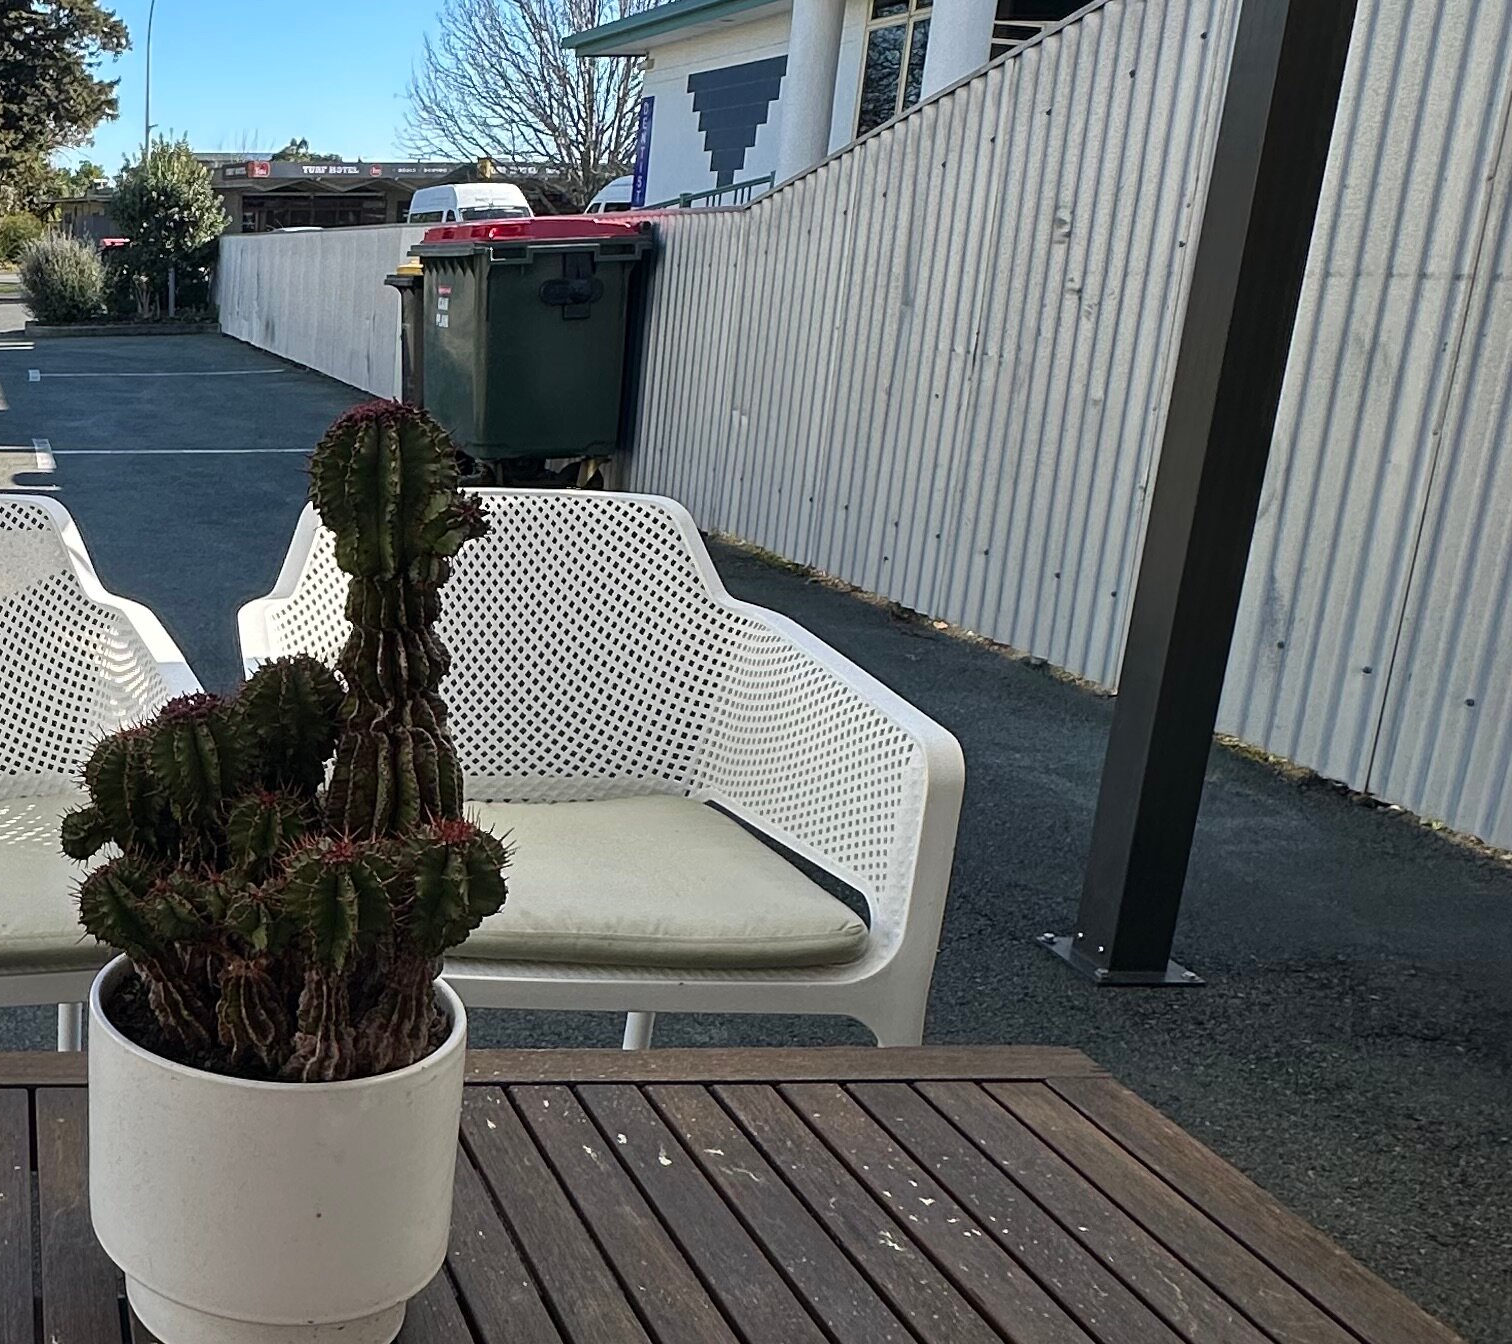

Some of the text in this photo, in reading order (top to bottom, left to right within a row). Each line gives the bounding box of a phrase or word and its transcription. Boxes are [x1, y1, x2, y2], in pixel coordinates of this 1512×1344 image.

[302, 165, 328, 174] TURF
[329, 165, 360, 174] HOTEL
[636, 101, 649, 205] DENTIST
